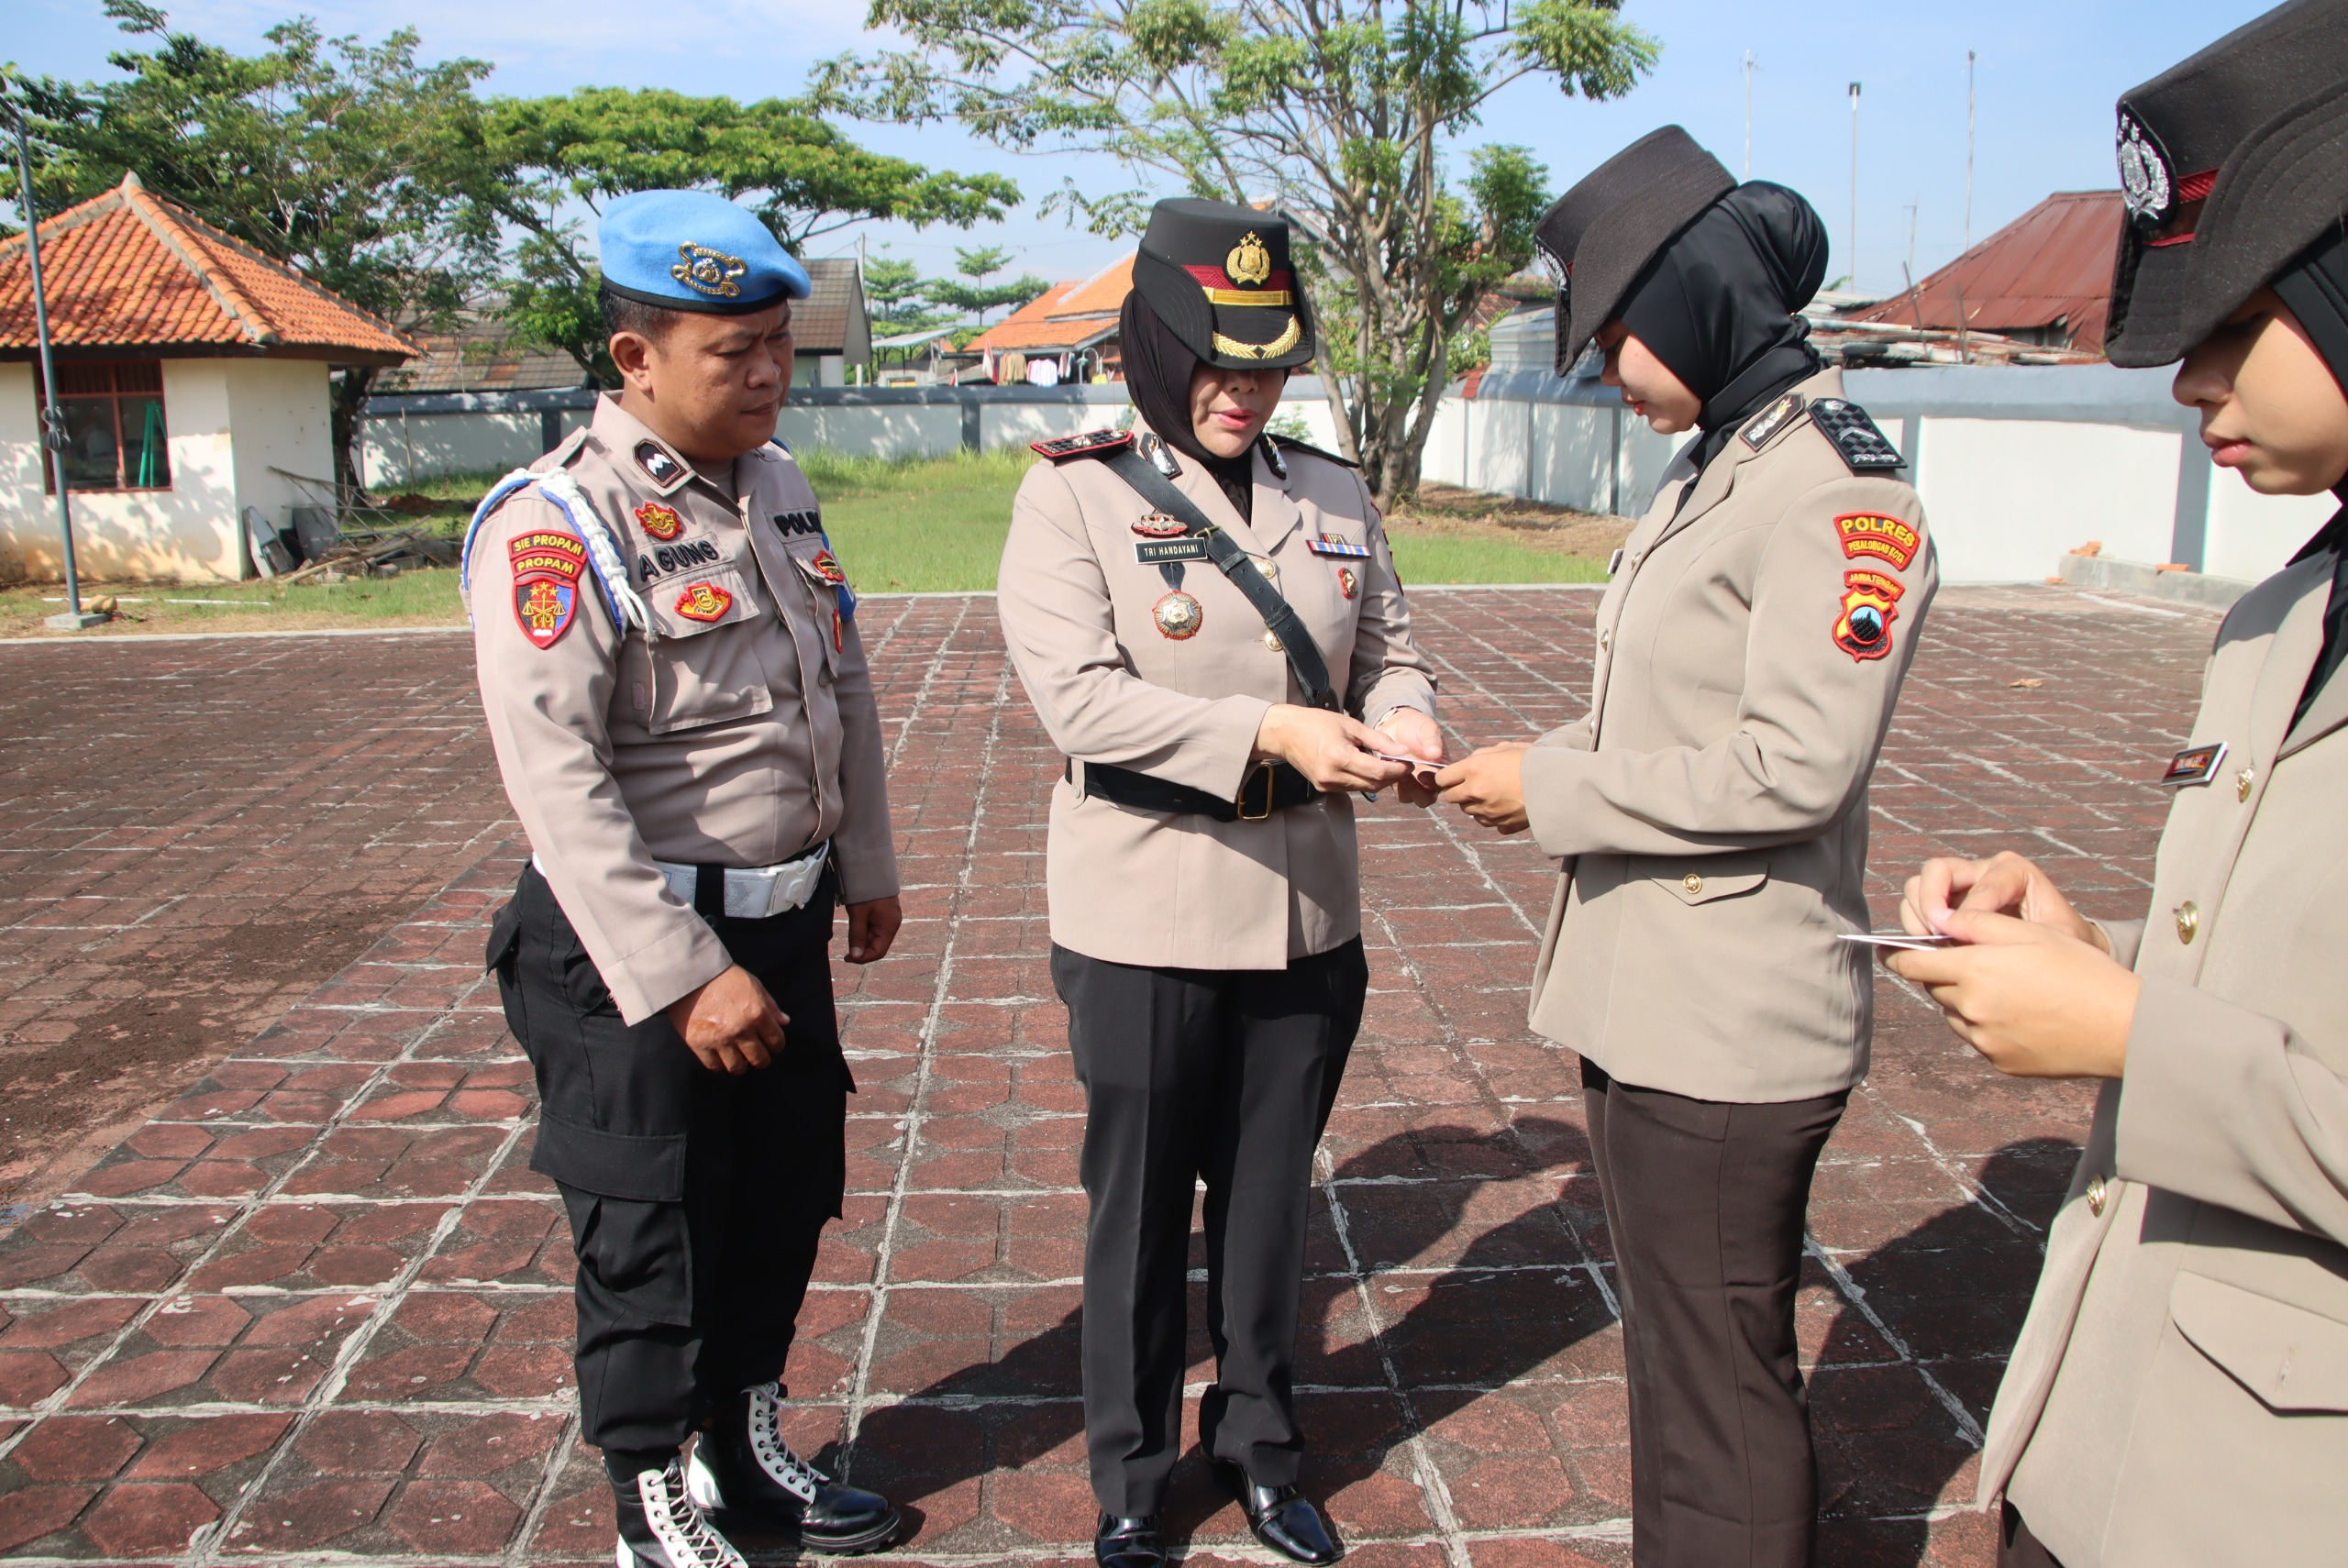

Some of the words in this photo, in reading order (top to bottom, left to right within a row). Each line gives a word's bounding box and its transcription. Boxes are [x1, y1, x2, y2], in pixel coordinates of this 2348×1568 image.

[1841, 516, 1916, 547] POLRES
[515, 537, 531, 552] SIE
[533, 535, 583, 556] PROPAM
[1144, 547, 1157, 557] TRI
[1158, 544, 1199, 556] HANDAYANI
[638, 539, 719, 582] AGUNG
[1888, 547, 1906, 565] KOTA
[516, 557, 574, 575] PROPAM
